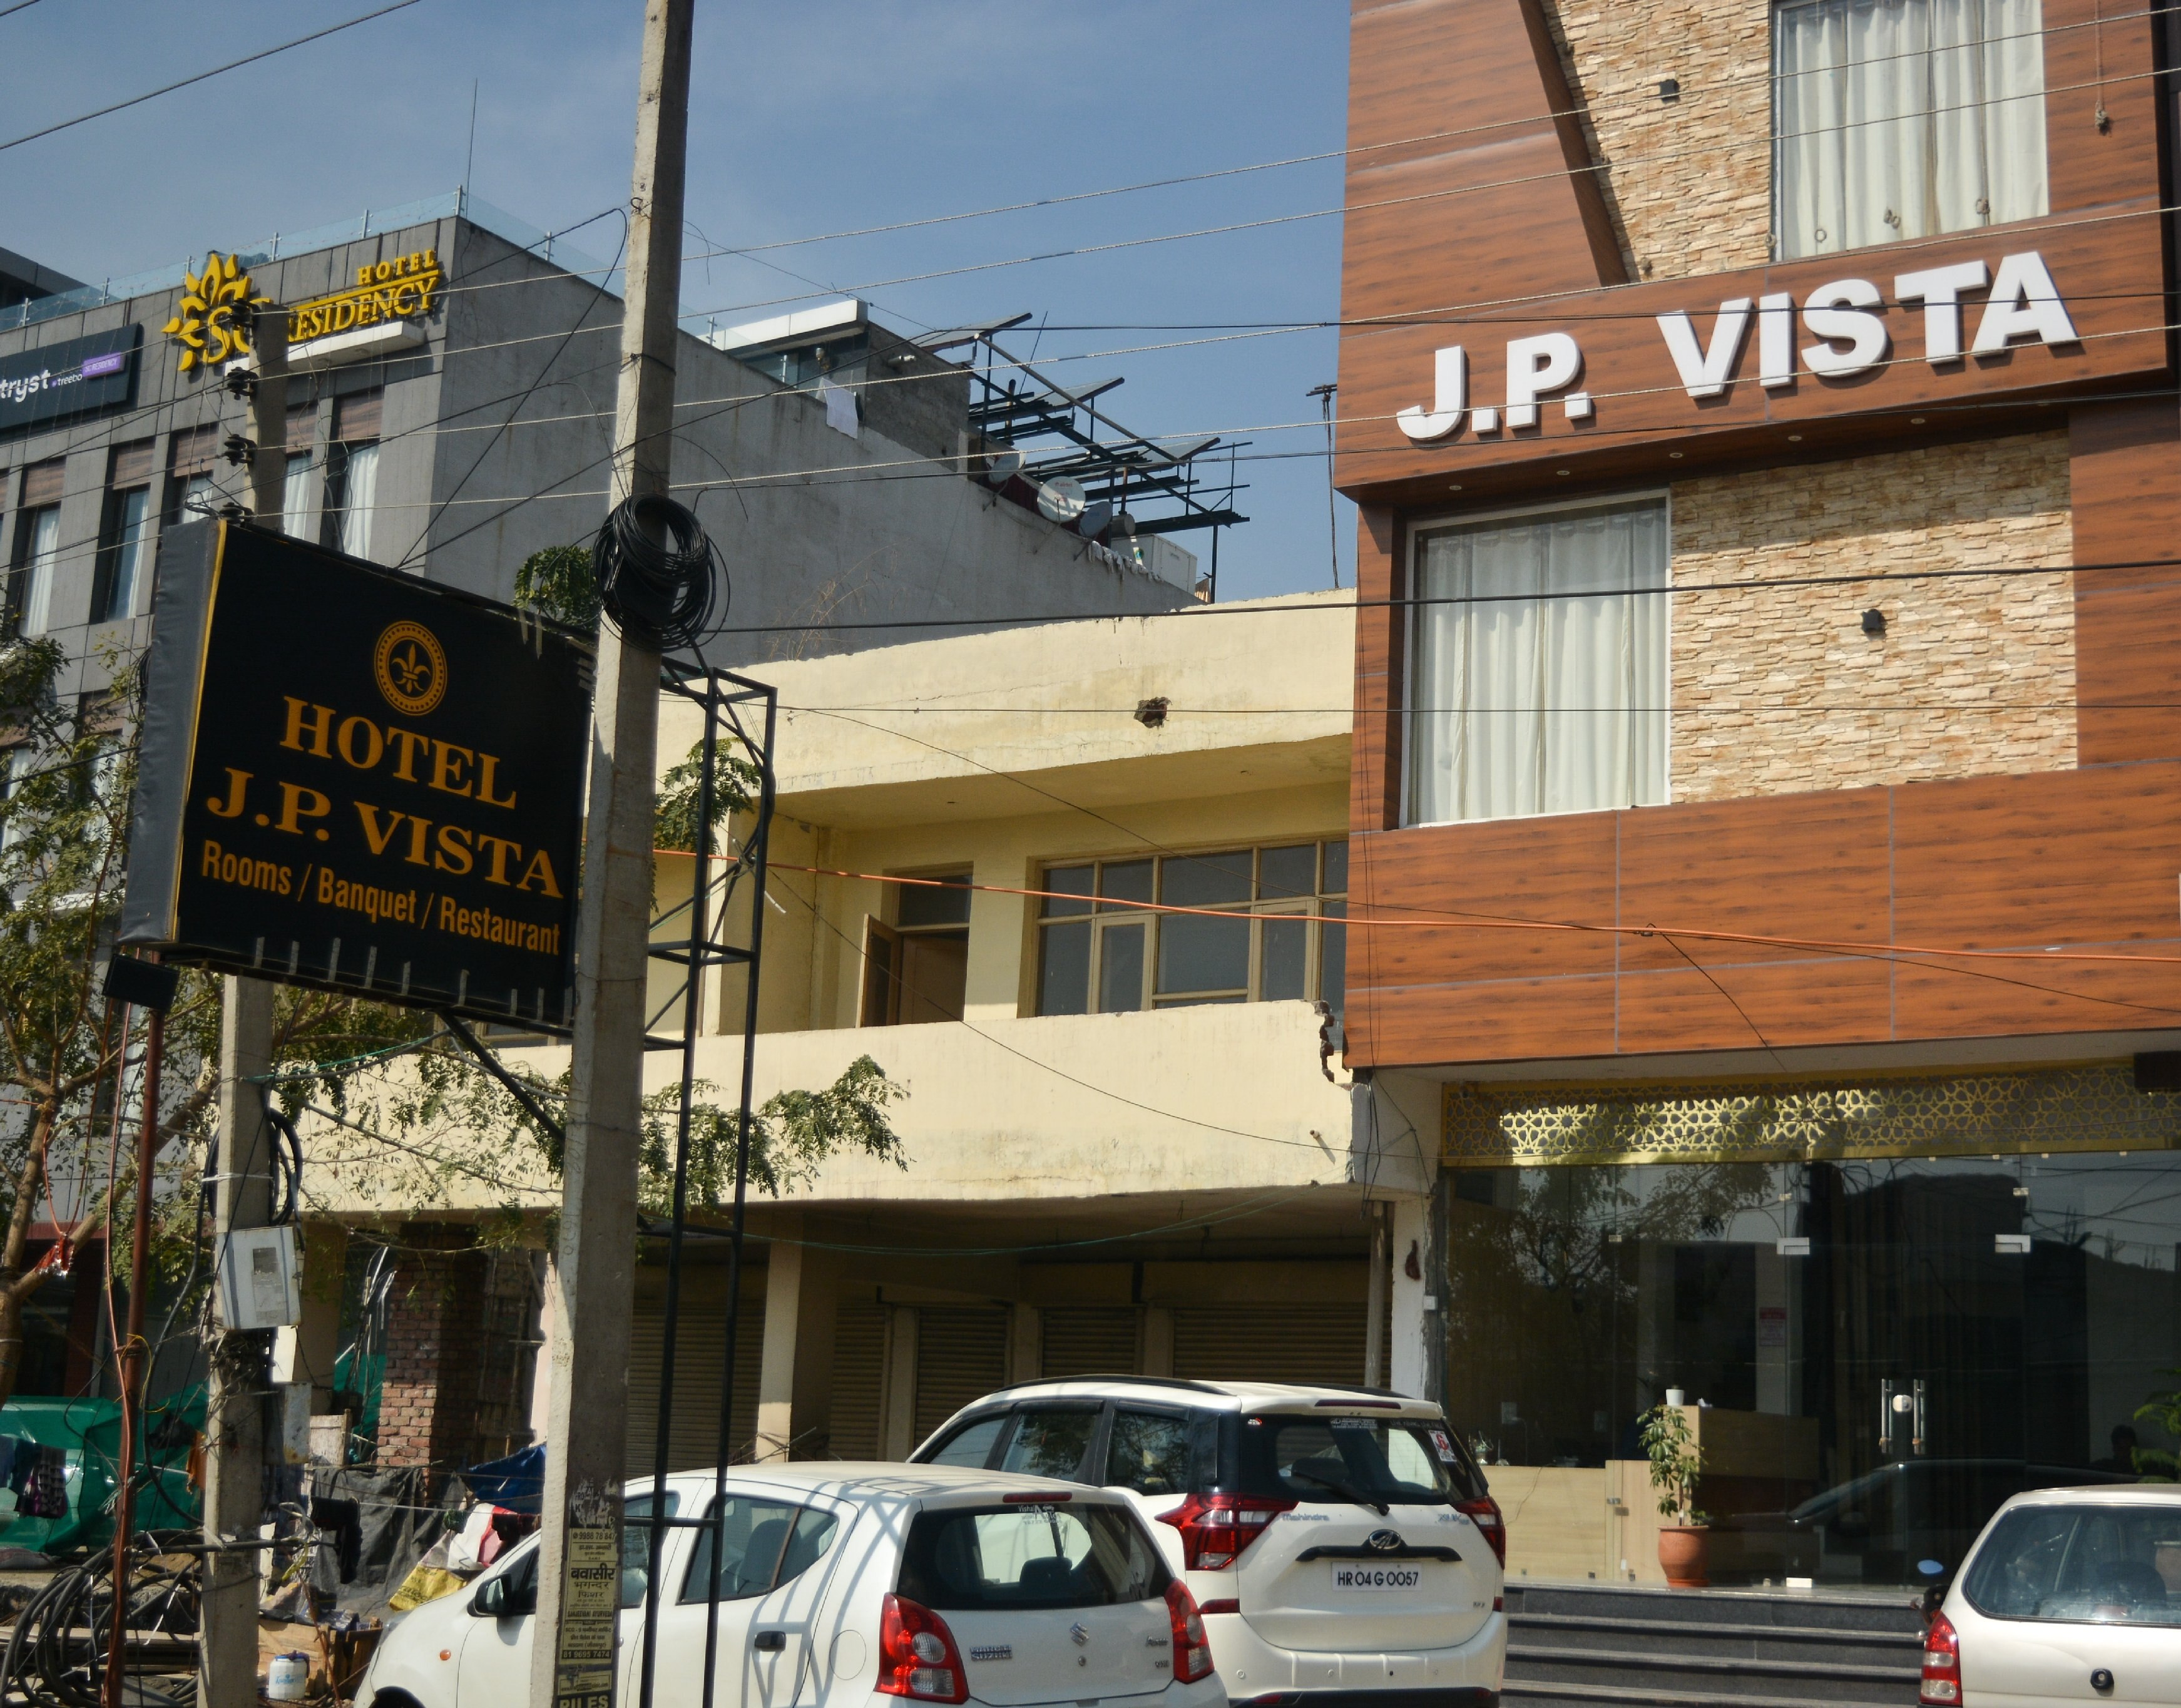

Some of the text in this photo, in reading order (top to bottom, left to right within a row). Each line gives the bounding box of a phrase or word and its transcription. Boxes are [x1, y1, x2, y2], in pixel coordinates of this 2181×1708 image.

[357, 248, 438, 286] HOTEL
[1396, 250, 2079, 441] J.P. VISTA
[0, 369, 83, 403] tryst treebo
[279, 695, 518, 810] HOTEL
[207, 767, 564, 900] J.P. VISTA
[202, 839, 292, 896] Rooms
[319, 867, 417, 924] Banquet
[440, 896, 561, 956] Restaurant
[1436, 1433, 1449, 1451] 6
[1281, 1513, 1330, 1521] Mahindra
[579, 1532, 594, 1540] 9988
[596, 1531, 603, 1540] 78
[570, 1562, 616, 1580] बवासीर
[1337, 1571, 1419, 1586] HR 04 G 0057
[574, 1581, 611, 1590] भगन्दर
[578, 1590, 605, 1598] फिशर
[563, 1650, 610, 1659] 81 9695 7474
[971, 1652, 1013, 1661] SUZUKI
